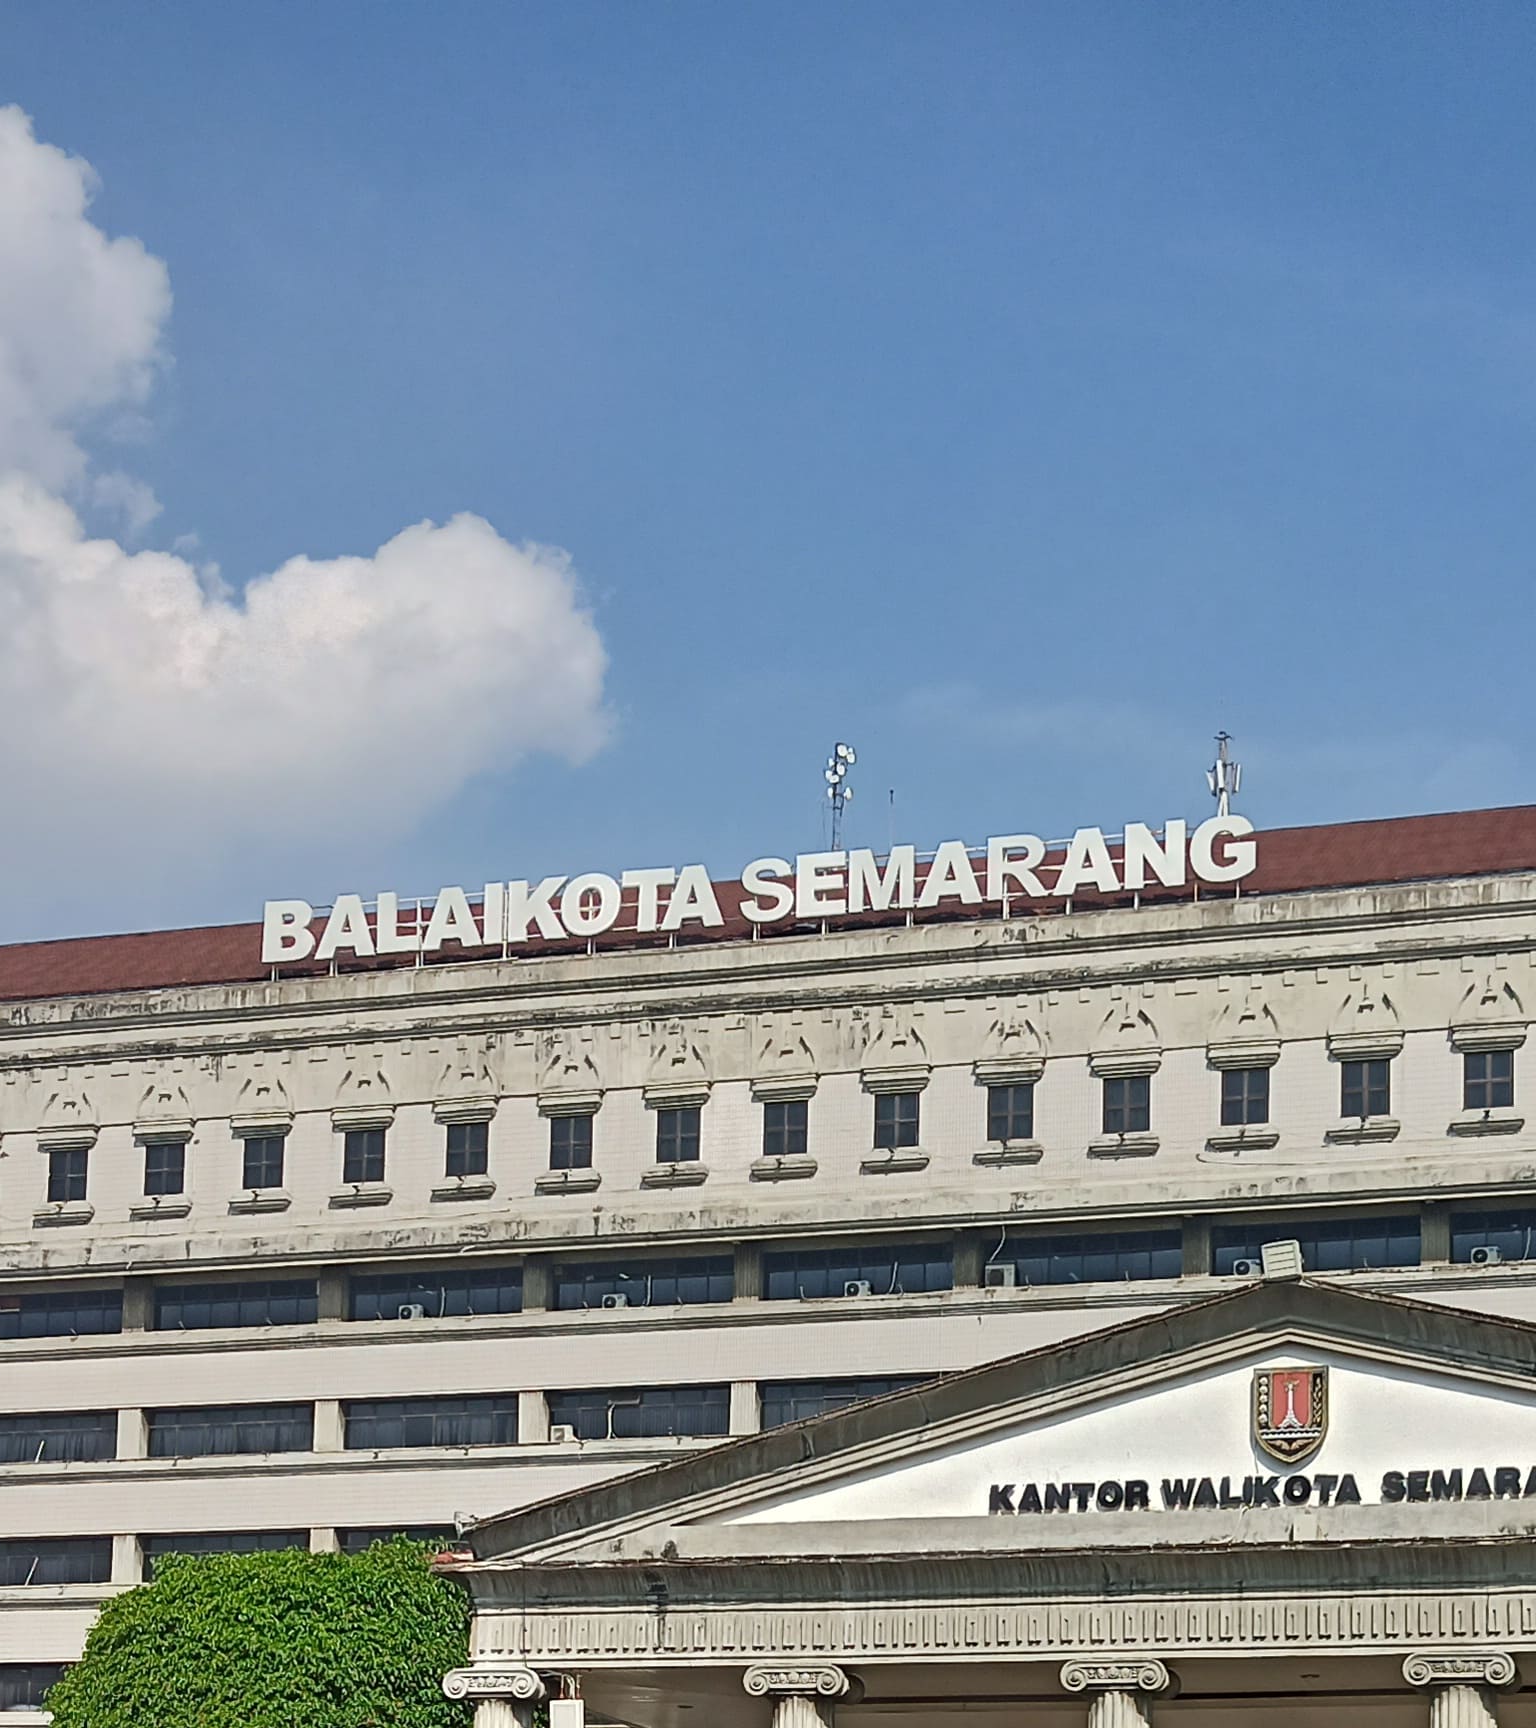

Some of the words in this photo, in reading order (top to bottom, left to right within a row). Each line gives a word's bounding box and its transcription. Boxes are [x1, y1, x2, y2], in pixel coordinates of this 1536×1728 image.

[261, 863, 725, 964] BALAIKOTA
[739, 814, 1257, 923] SEMARANG
[988, 1480, 1150, 1515] KANTOR
[1160, 1474, 1362, 1512] WALIKOTA
